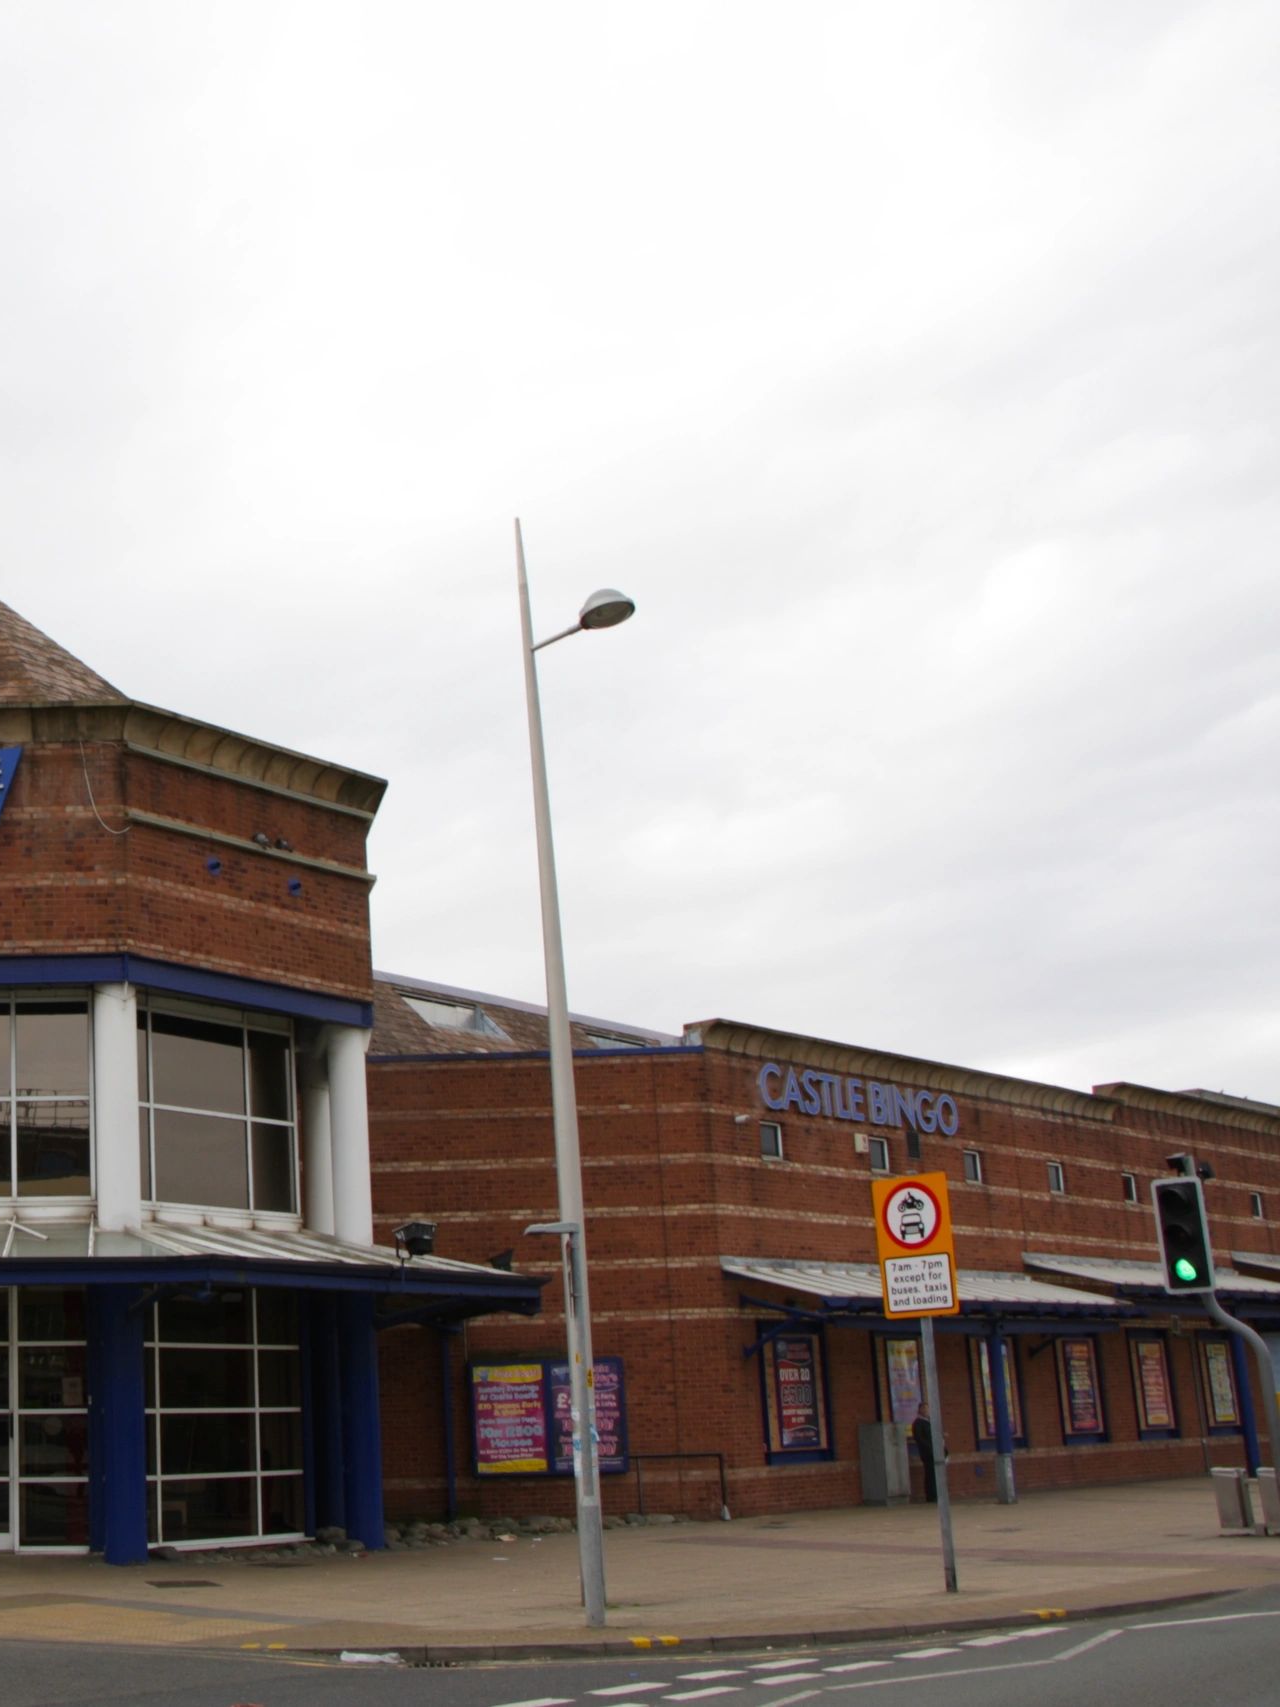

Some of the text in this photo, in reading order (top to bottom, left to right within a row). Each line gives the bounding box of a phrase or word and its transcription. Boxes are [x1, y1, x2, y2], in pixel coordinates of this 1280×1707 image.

[757, 1062, 959, 1136] CASTLE BINGO
[891, 1263, 912, 1272] 7am
[921, 1260, 943, 1270] 7pm
[893, 1271, 942, 1283] except for
[924, 1283, 948, 1293] taxis
[893, 1294, 948, 1307] and loading
